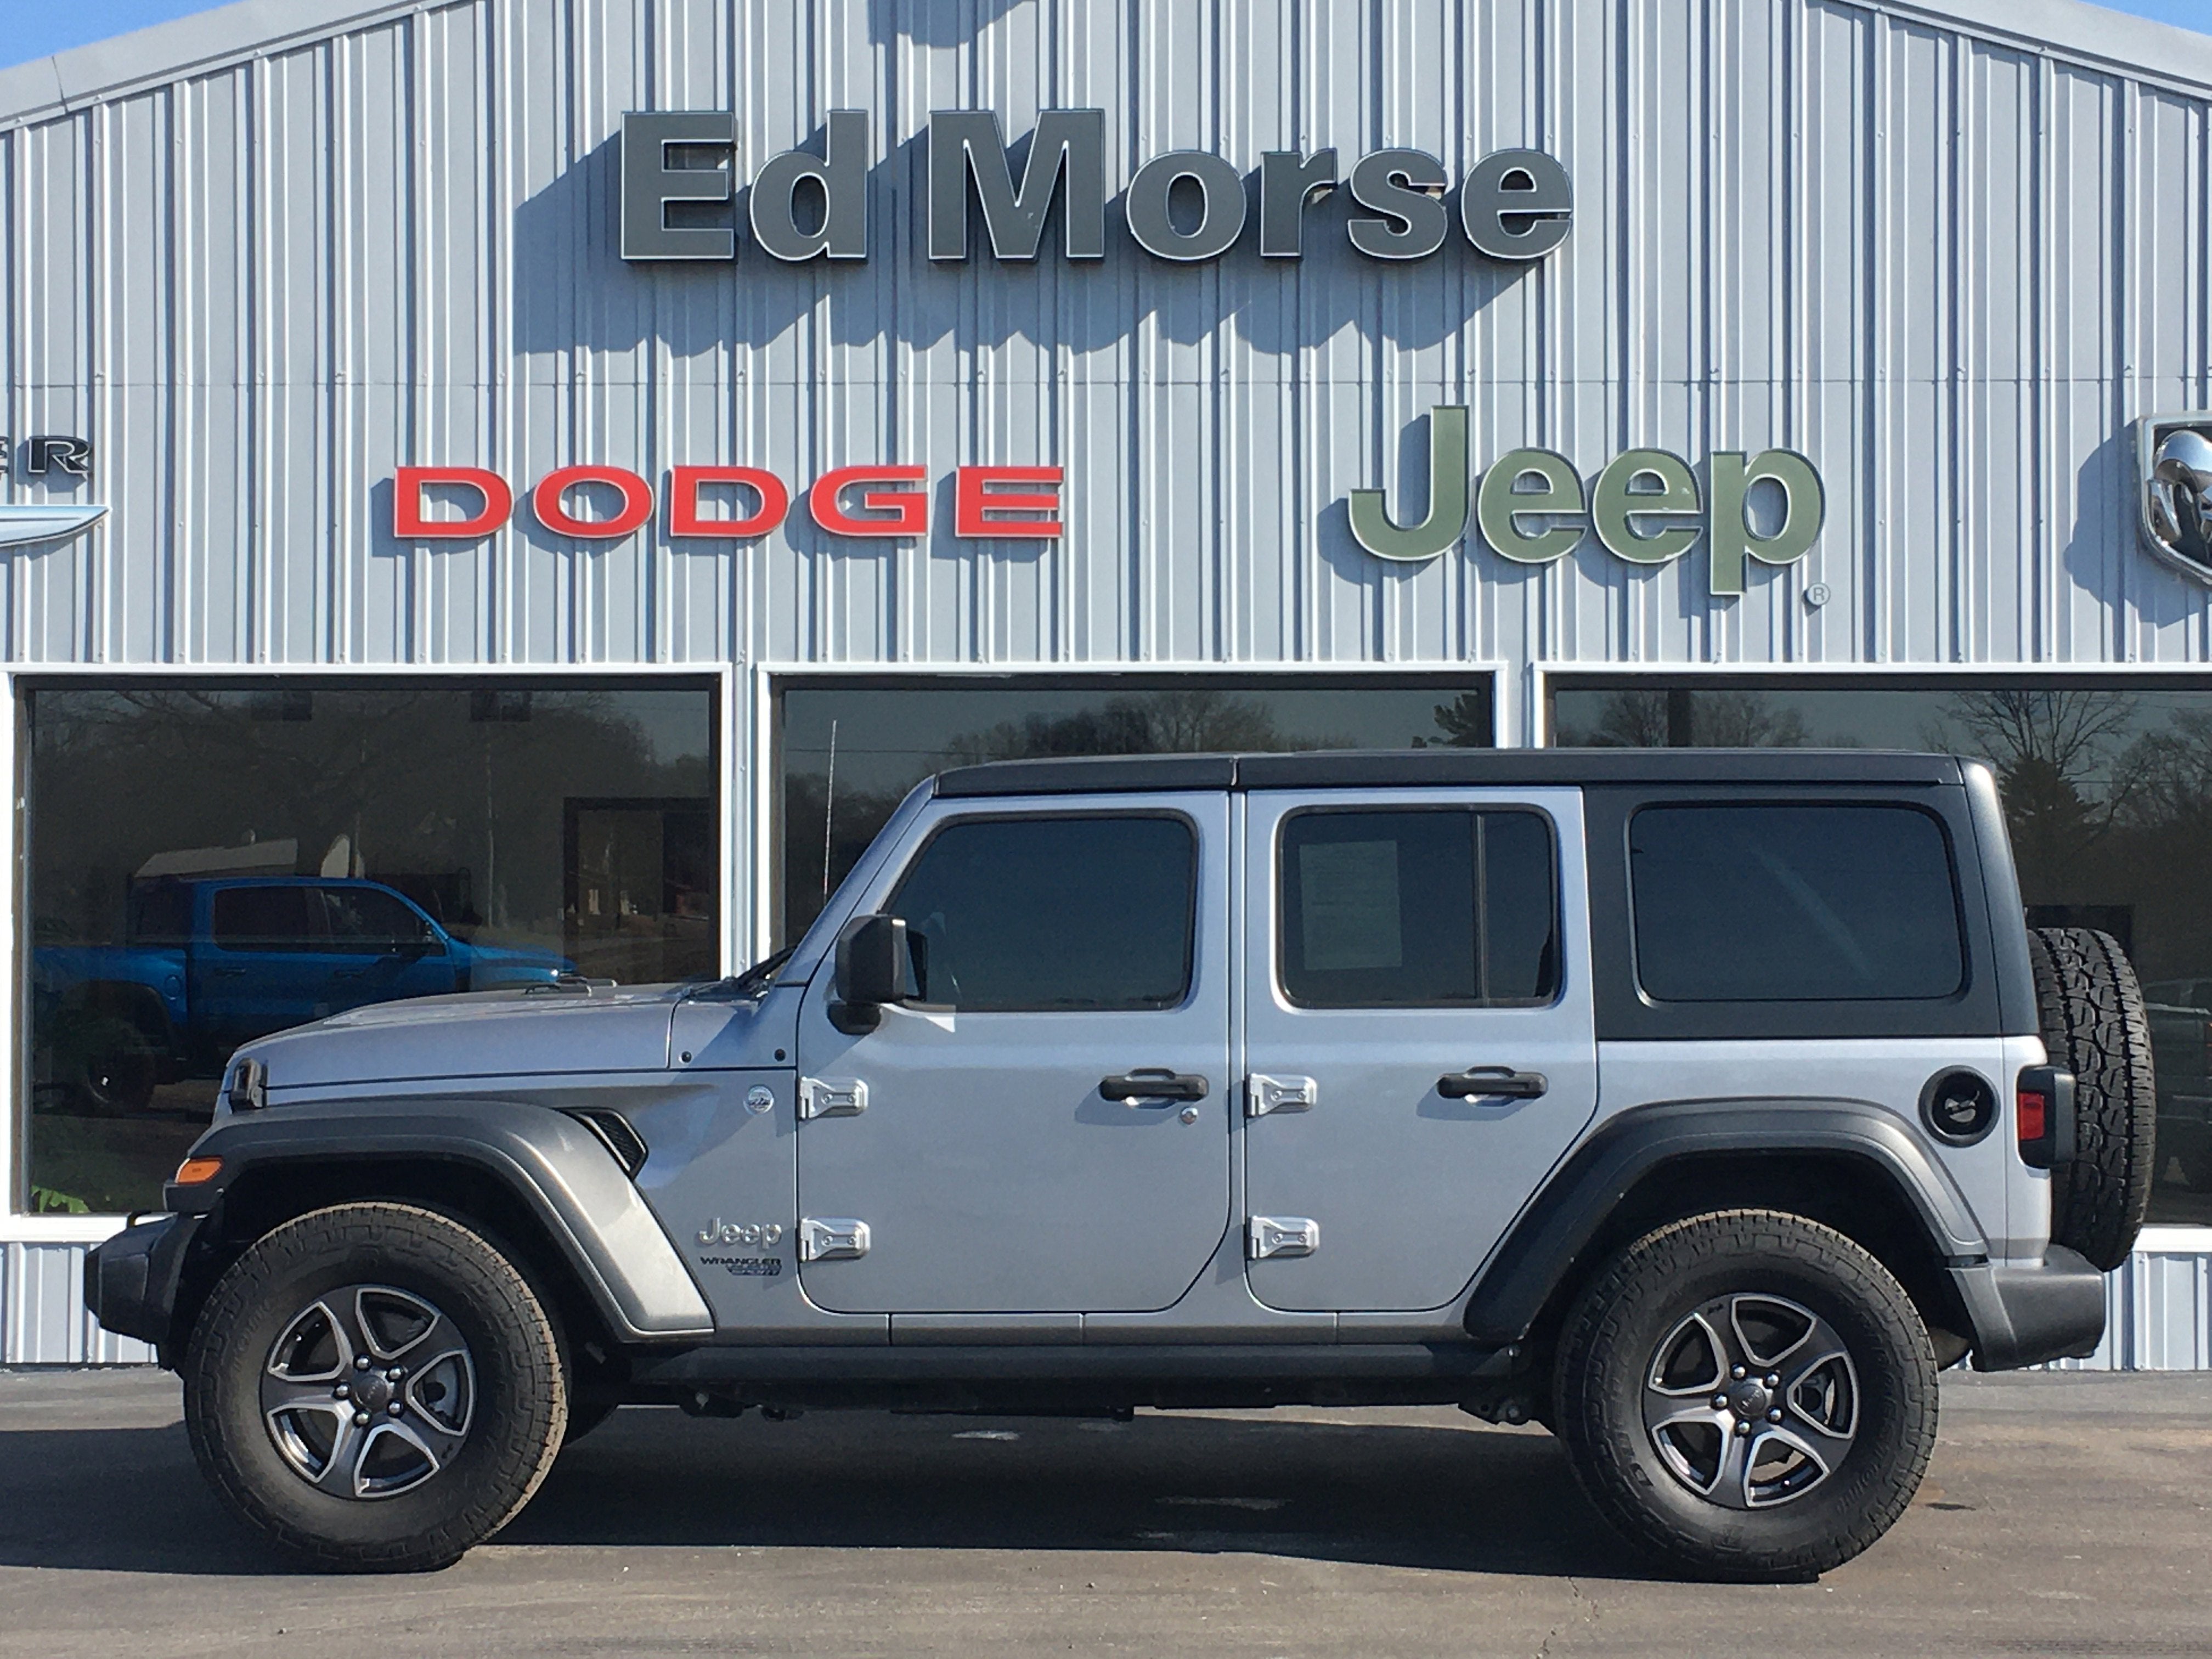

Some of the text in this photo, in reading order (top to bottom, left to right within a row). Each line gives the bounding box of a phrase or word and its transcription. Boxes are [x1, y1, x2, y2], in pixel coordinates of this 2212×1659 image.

[620, 109, 1574, 261] Ed Morse
[0, 436, 91, 473] R
[393, 465, 1064, 539] DODGE
[1348, 405, 1826, 596] Jeep
[698, 1217, 782, 1249] Jeep
